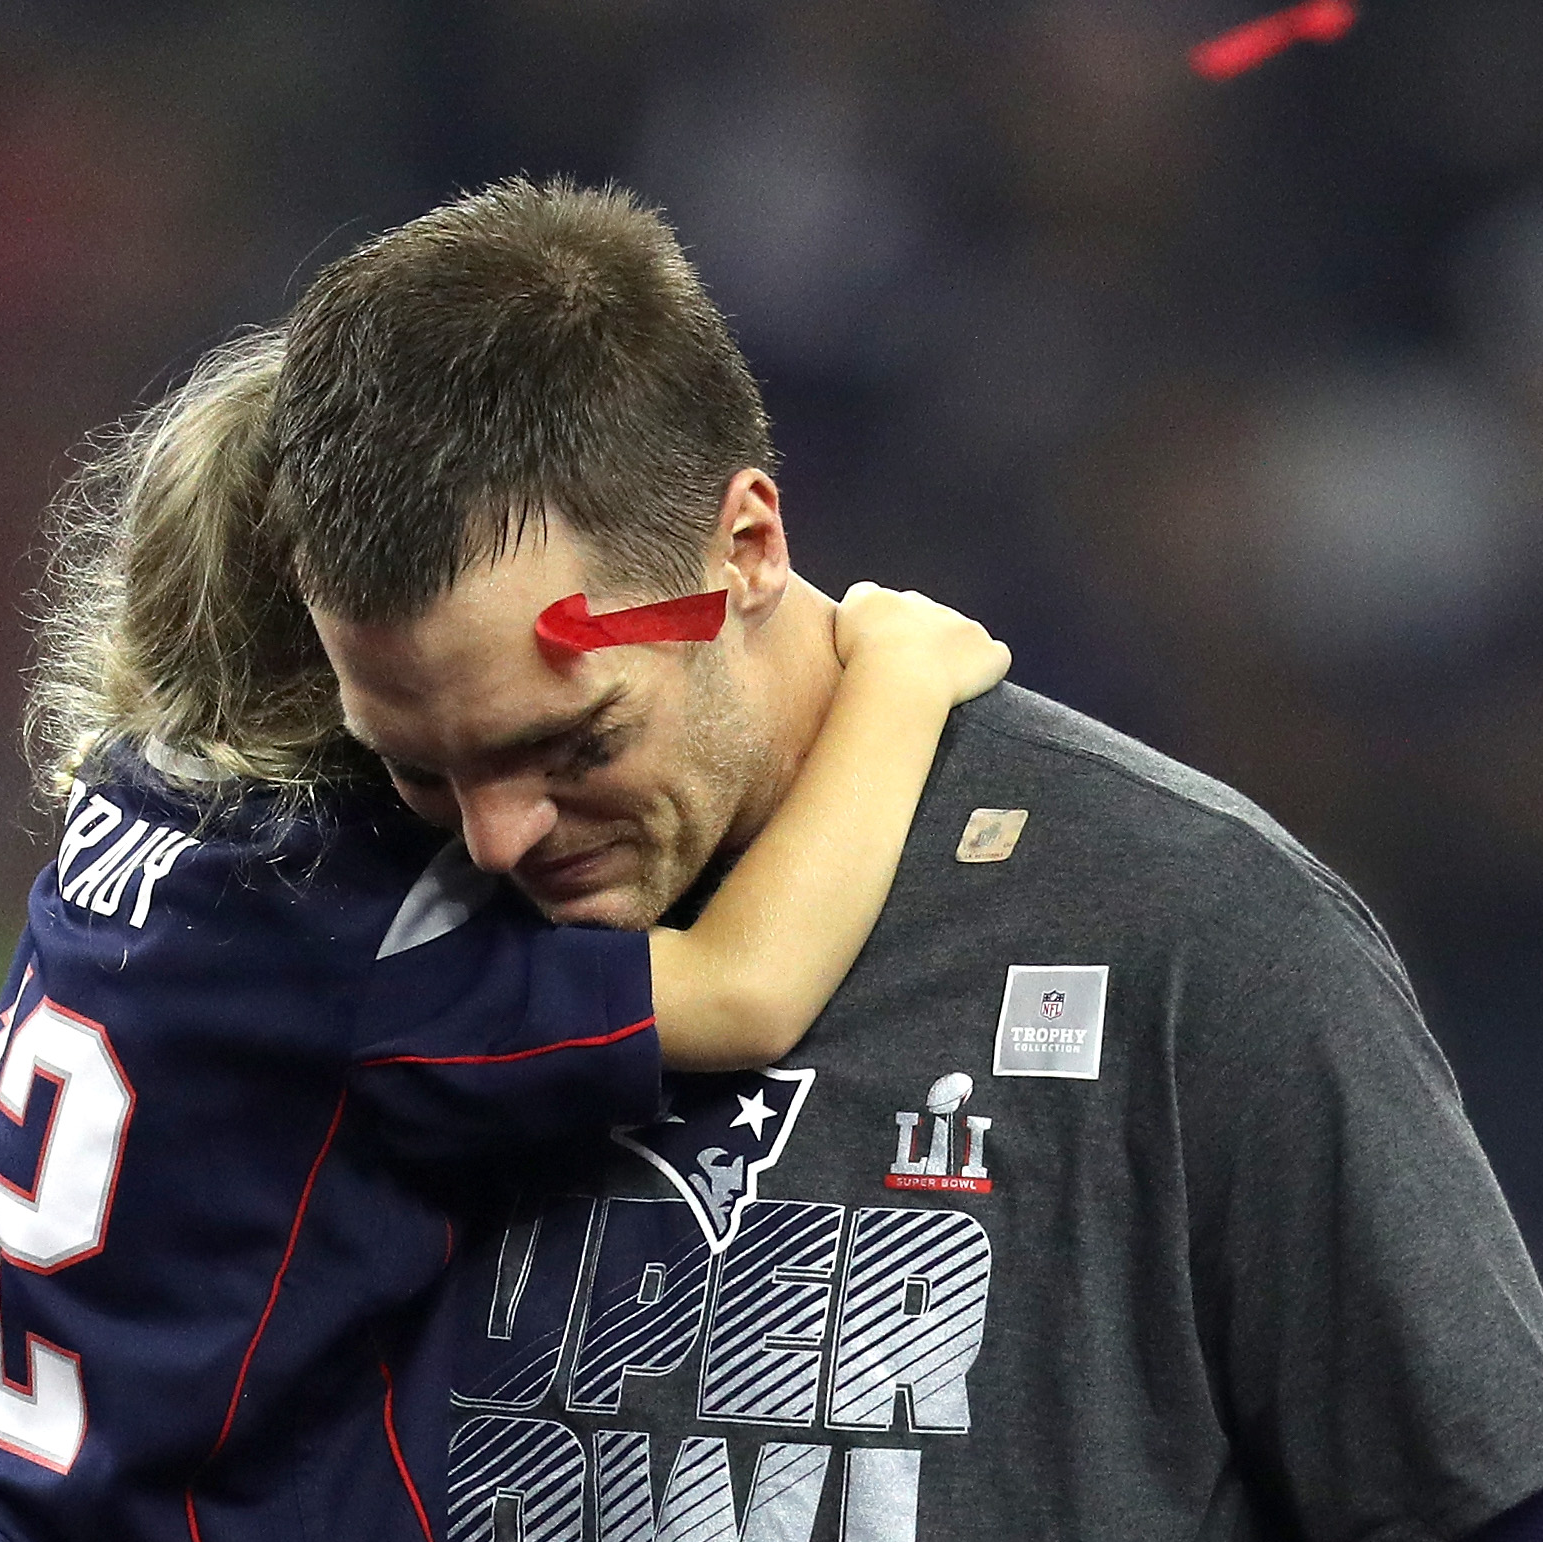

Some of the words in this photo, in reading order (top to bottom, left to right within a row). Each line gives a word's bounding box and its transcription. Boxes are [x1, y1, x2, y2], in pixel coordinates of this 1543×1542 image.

[1042, 1003, 1063, 1017] NFL
[1010, 1027, 1088, 1044] TROPHY
[1014, 1043, 1081, 1053] COLLECTION
[896, 1177, 936, 1187] SUPER
[941, 1178, 977, 1190] BOWL
[450, 1197, 992, 1434] UPER
